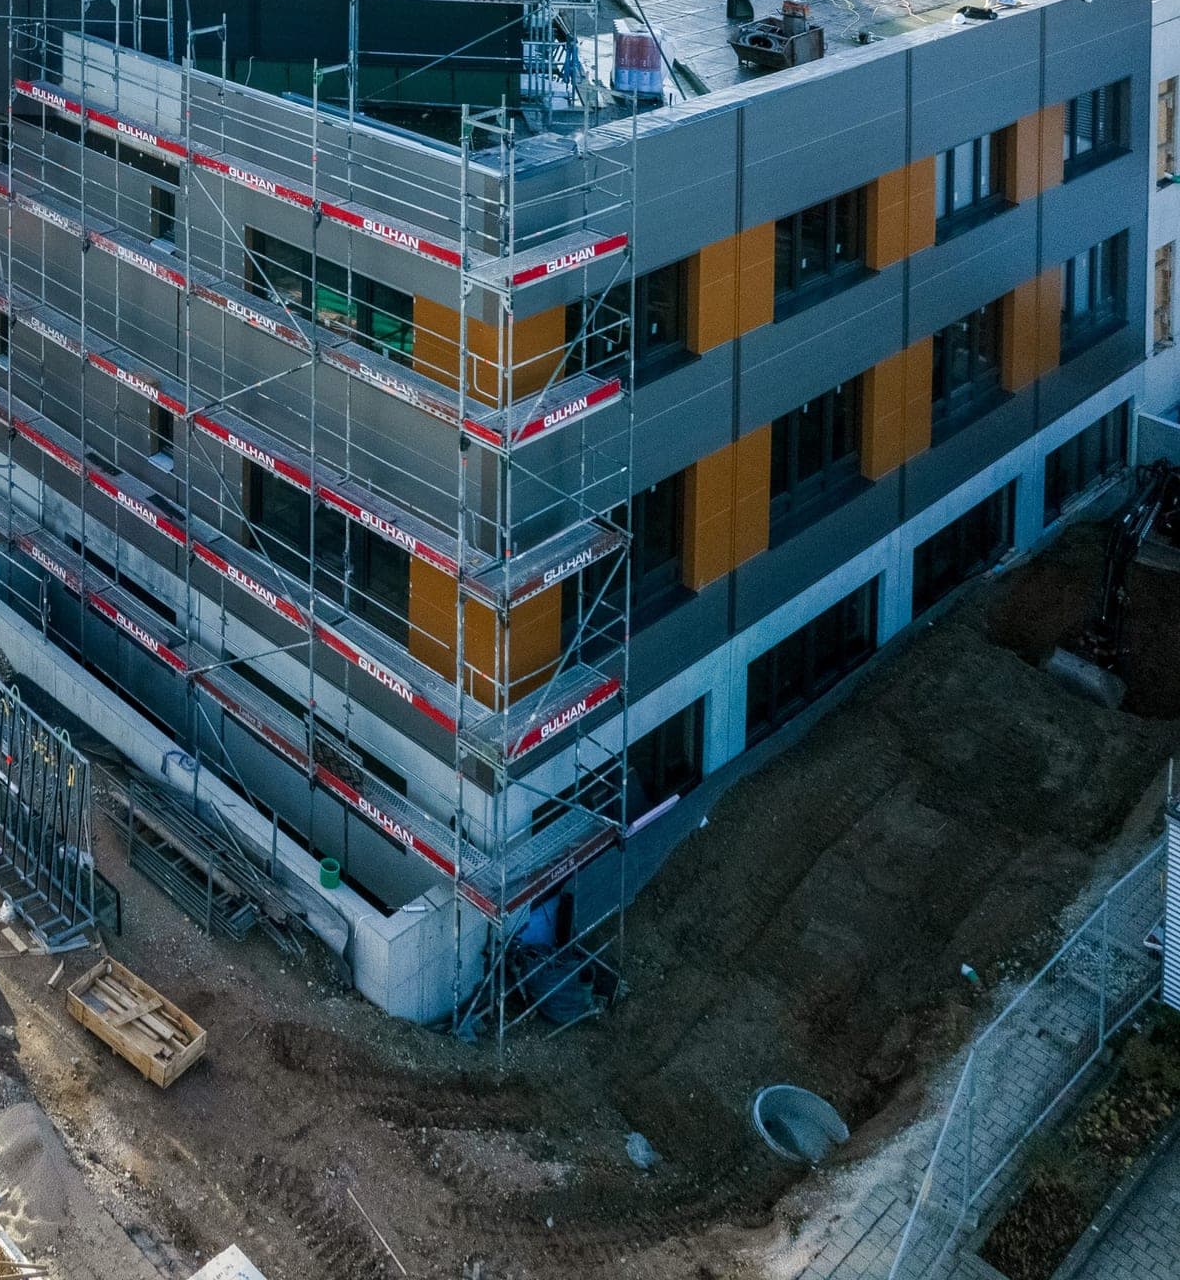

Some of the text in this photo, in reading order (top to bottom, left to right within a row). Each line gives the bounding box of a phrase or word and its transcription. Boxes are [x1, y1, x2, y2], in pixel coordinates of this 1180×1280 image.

[32, 86, 66, 107] GULHAN
[117, 122, 158, 145] GULHAN
[228, 166, 276, 193] GULHAN
[362, 218, 420, 249] GULHAN
[117, 246, 158, 271] GULHAN
[546, 246, 596, 273] GULHAN
[31, 316, 68, 346] GULHAN
[227, 299, 277, 331] GULHAN
[116, 368, 159, 400] GULHAN
[544, 396, 588, 428] GULHAN
[228, 428, 275, 468] GULHAN
[117, 491, 158, 524] GULHAN
[360, 510, 416, 549] GULHAN
[544, 548, 593, 584] GULHAN
[228, 566, 277, 606] GULHAN
[116, 612, 158, 652] GULHAN
[358, 657, 414, 704] GULHAN
[540, 700, 587, 738] GULHAN
[358, 798, 414, 845] GULHAN
